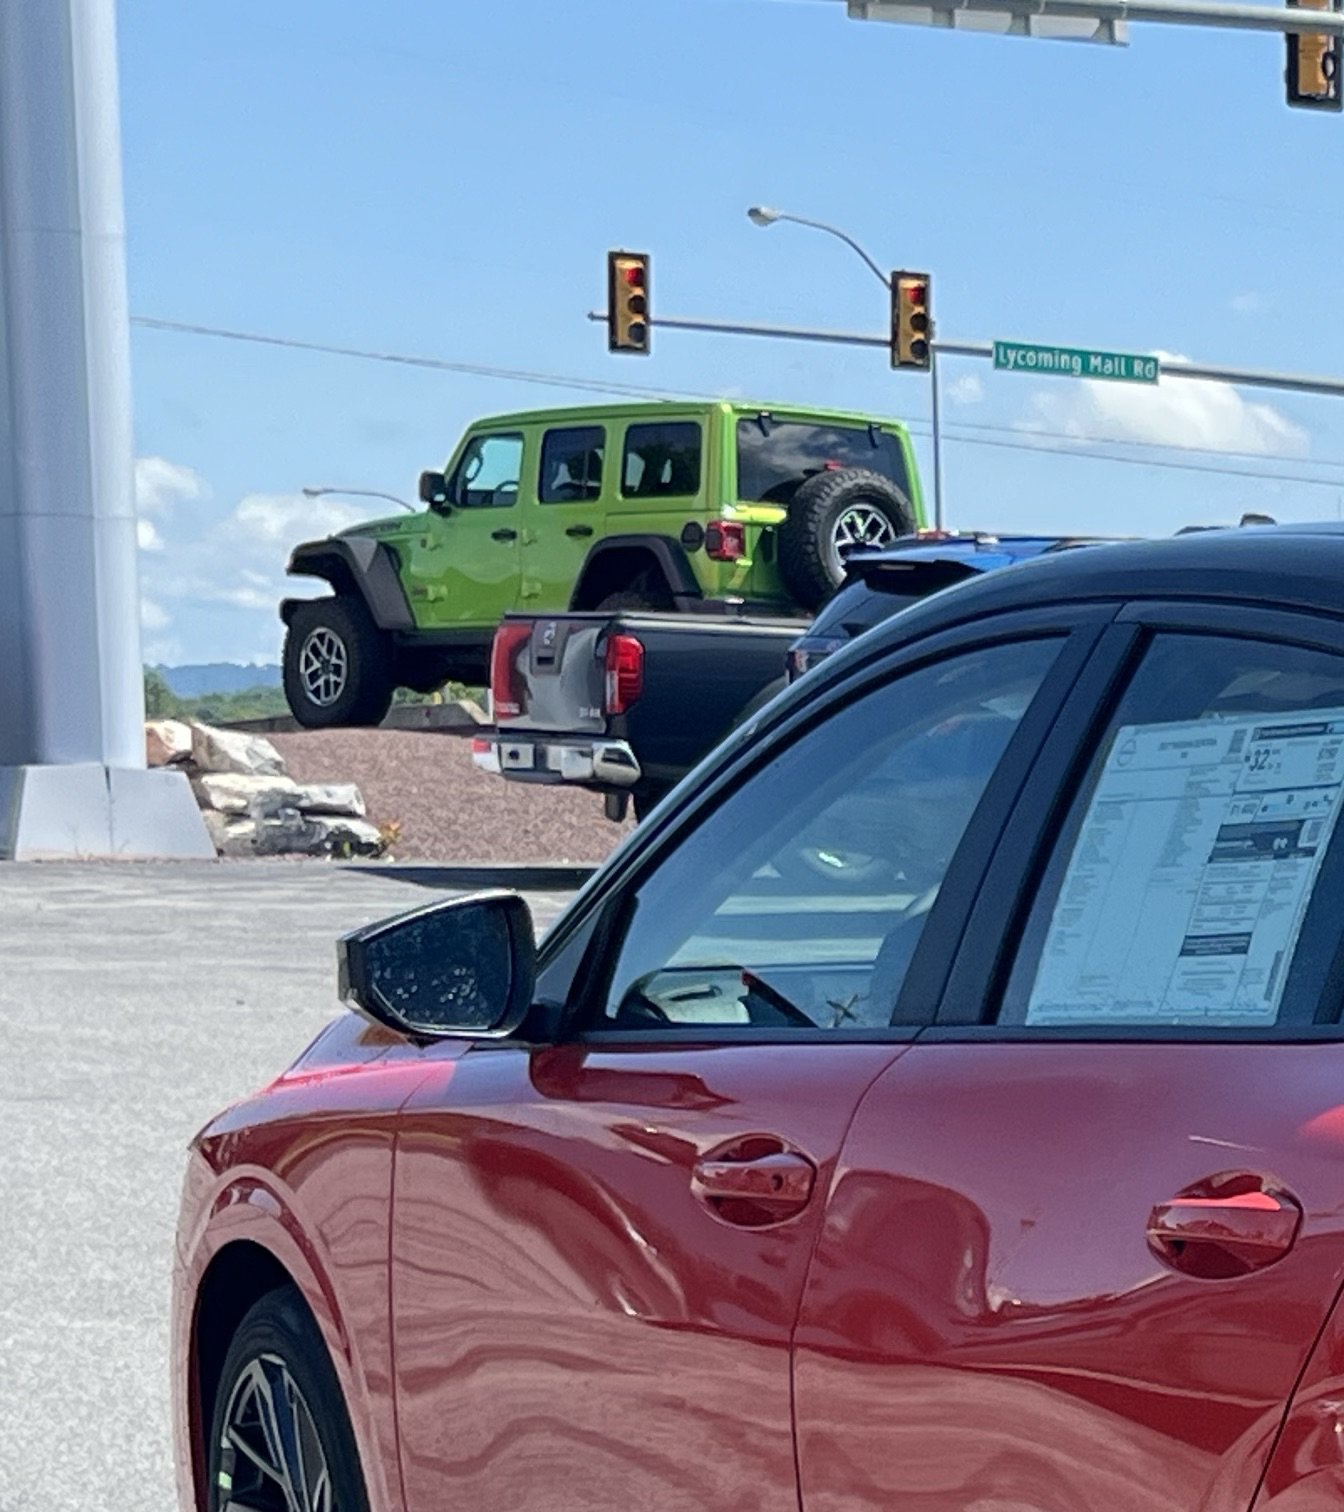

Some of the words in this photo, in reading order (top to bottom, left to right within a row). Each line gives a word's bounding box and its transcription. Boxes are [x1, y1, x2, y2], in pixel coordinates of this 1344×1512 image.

[999, 345, 1082, 376] Lycoming
[1088, 355, 1126, 377] Mall
[1133, 359, 1156, 379] Rd
